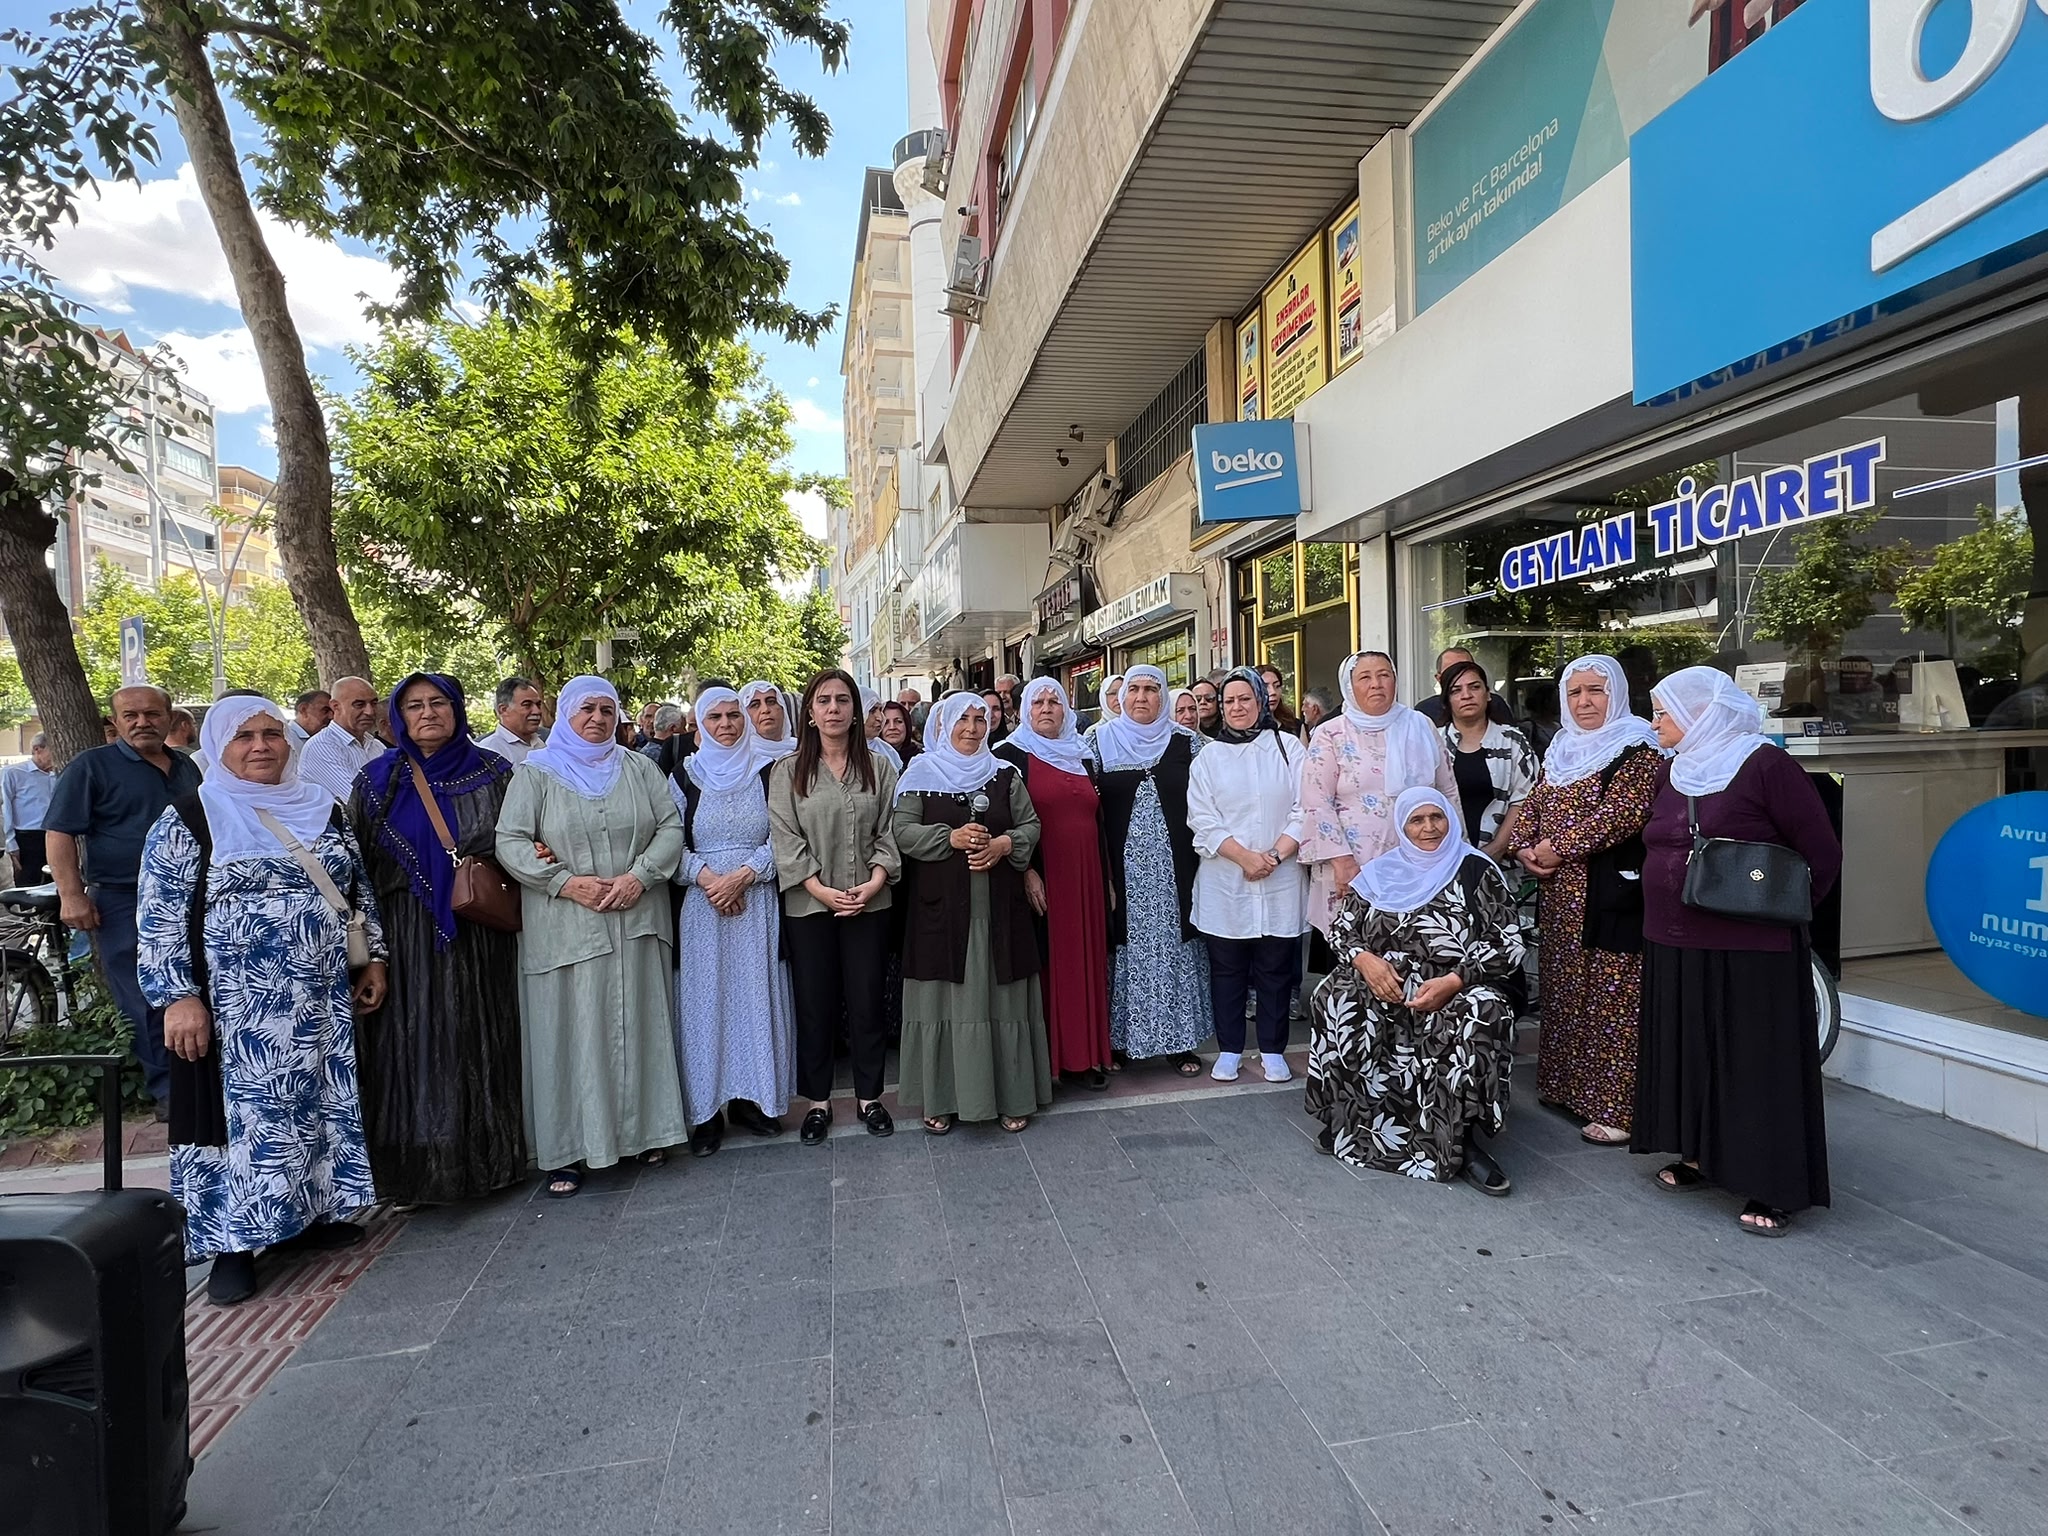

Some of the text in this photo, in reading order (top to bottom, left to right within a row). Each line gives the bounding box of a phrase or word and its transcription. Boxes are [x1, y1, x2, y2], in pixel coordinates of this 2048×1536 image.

[1869, 0, 2048, 122] b
[1427, 117, 1559, 242] Beko ve FC Barcelona
[1427, 151, 1542, 265] artık aynı takımda!
[1211, 447, 1284, 474] beko
[1501, 436, 1886, 593] CEYLAN TİCARET
[1135, 577, 1167, 613] EMLAK
[892, 599, 902, 652] LAGERS
[124, 627, 139, 676] P
[2000, 825, 2048, 843] Avru
[1969, 931, 2048, 958] beyaz eşya
